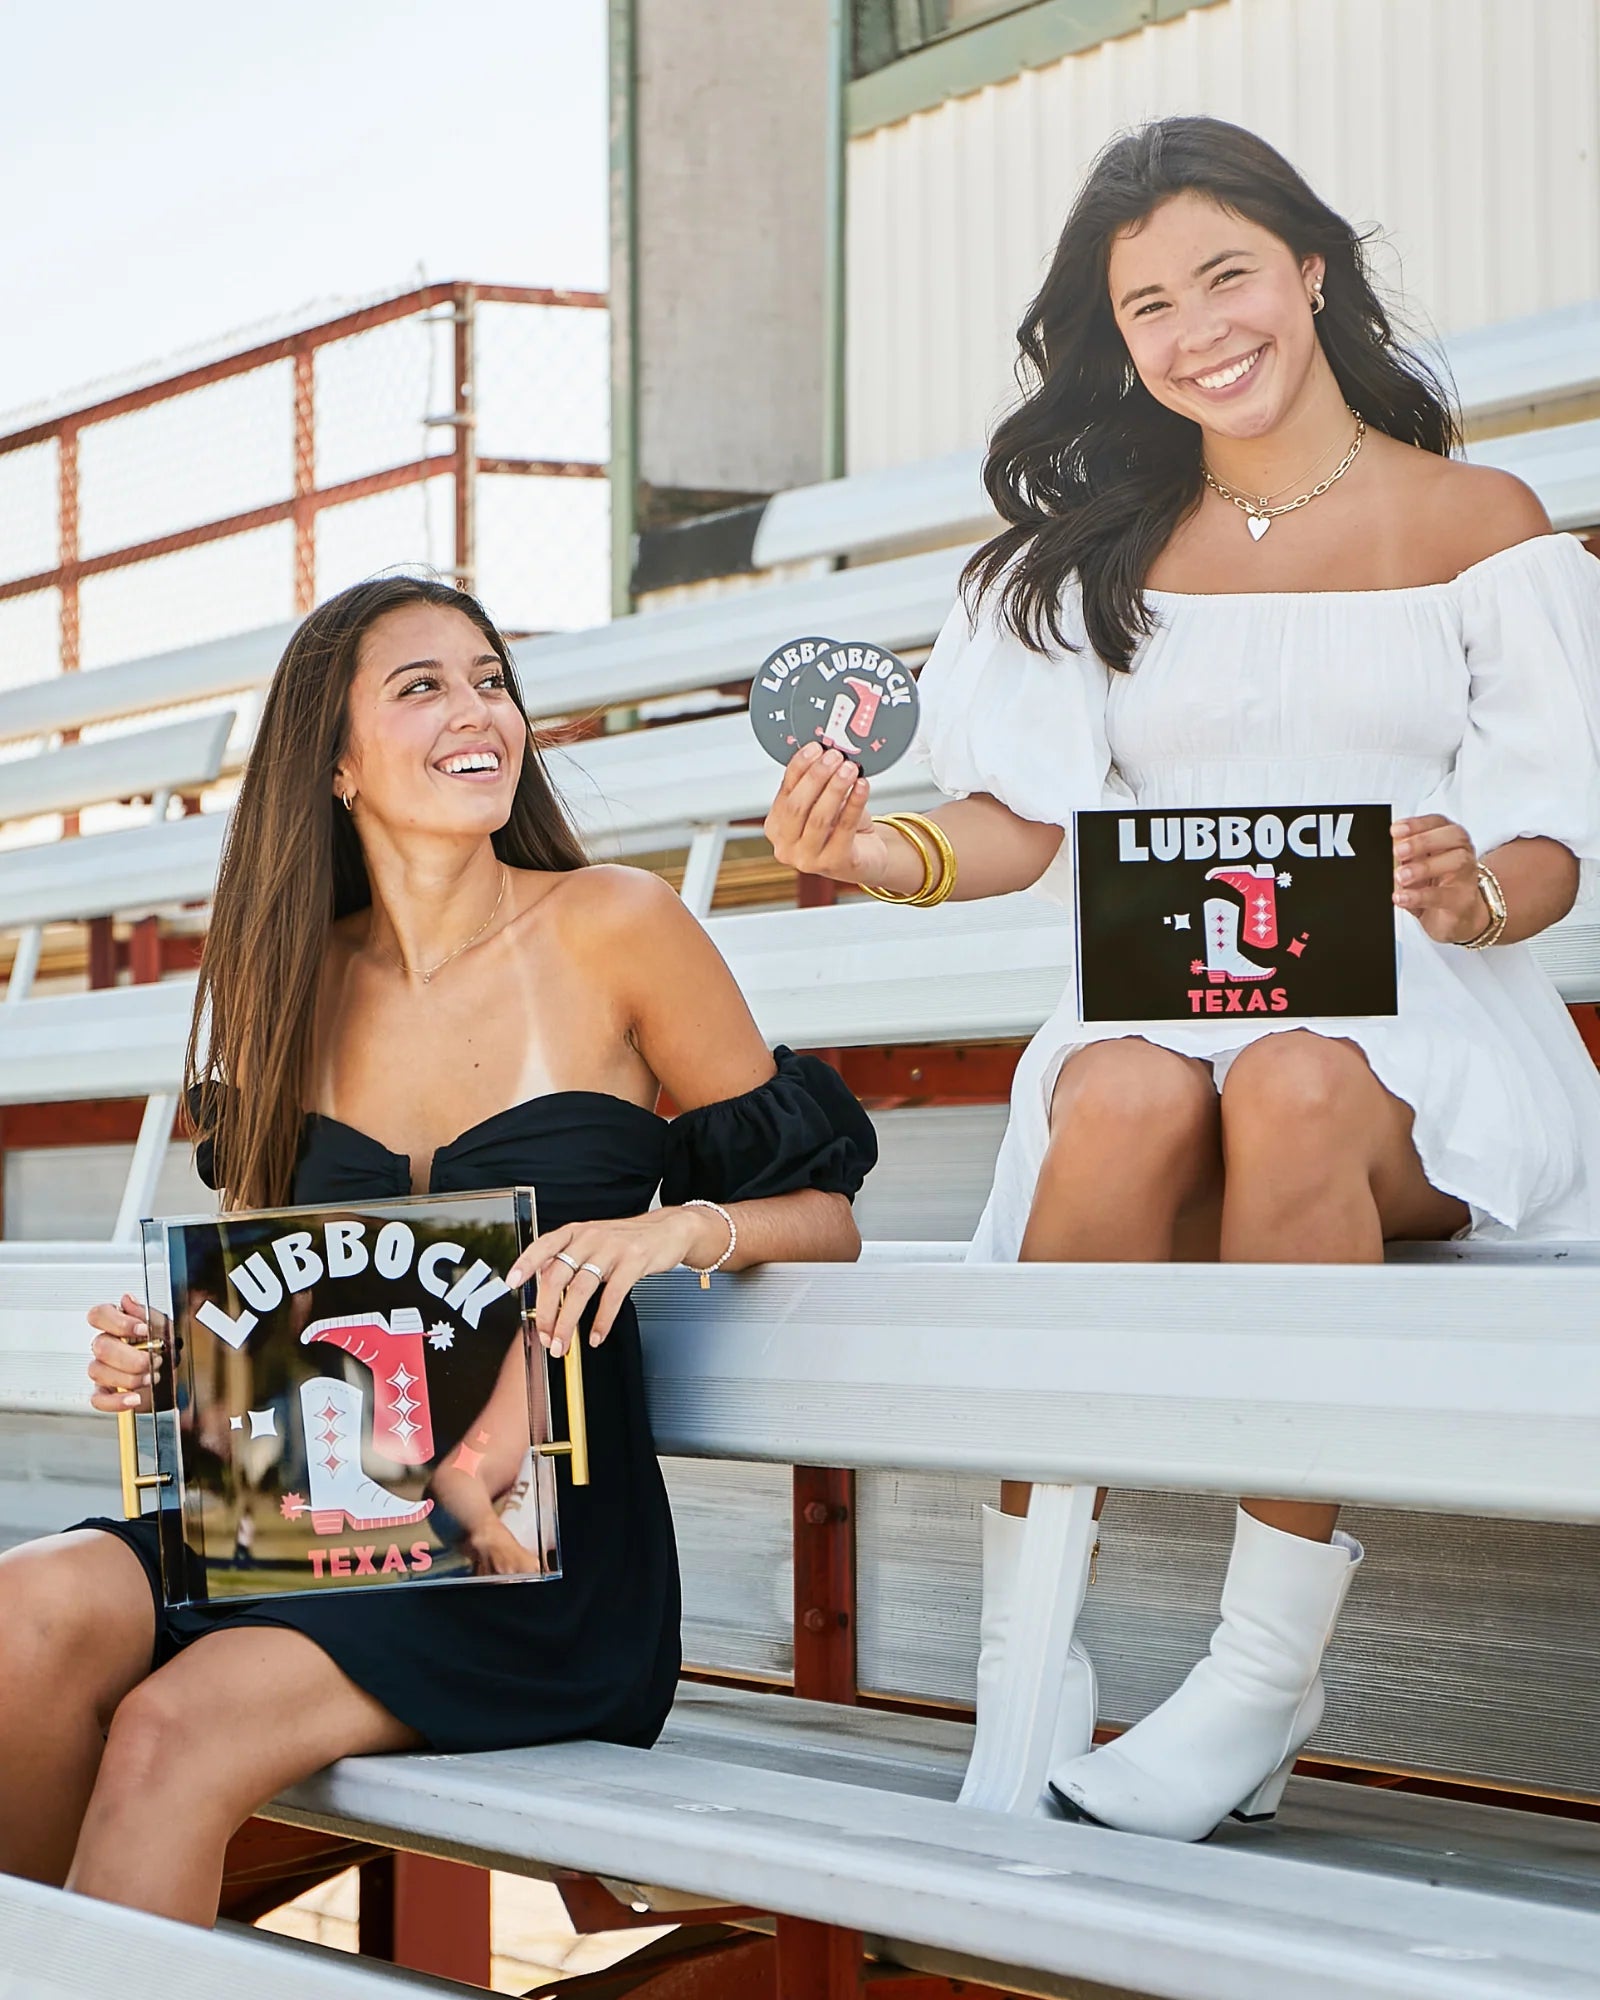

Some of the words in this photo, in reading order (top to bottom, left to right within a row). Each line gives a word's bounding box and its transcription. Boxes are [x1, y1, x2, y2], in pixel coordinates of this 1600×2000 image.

[817, 648, 911, 707] LUBBOCK
[1118, 813, 1356, 862] LUBBOCK
[1188, 988, 1288, 1013] TEXAS
[195, 1221, 512, 1350] LUBBOCK
[308, 1541, 433, 1578] TEXAS
